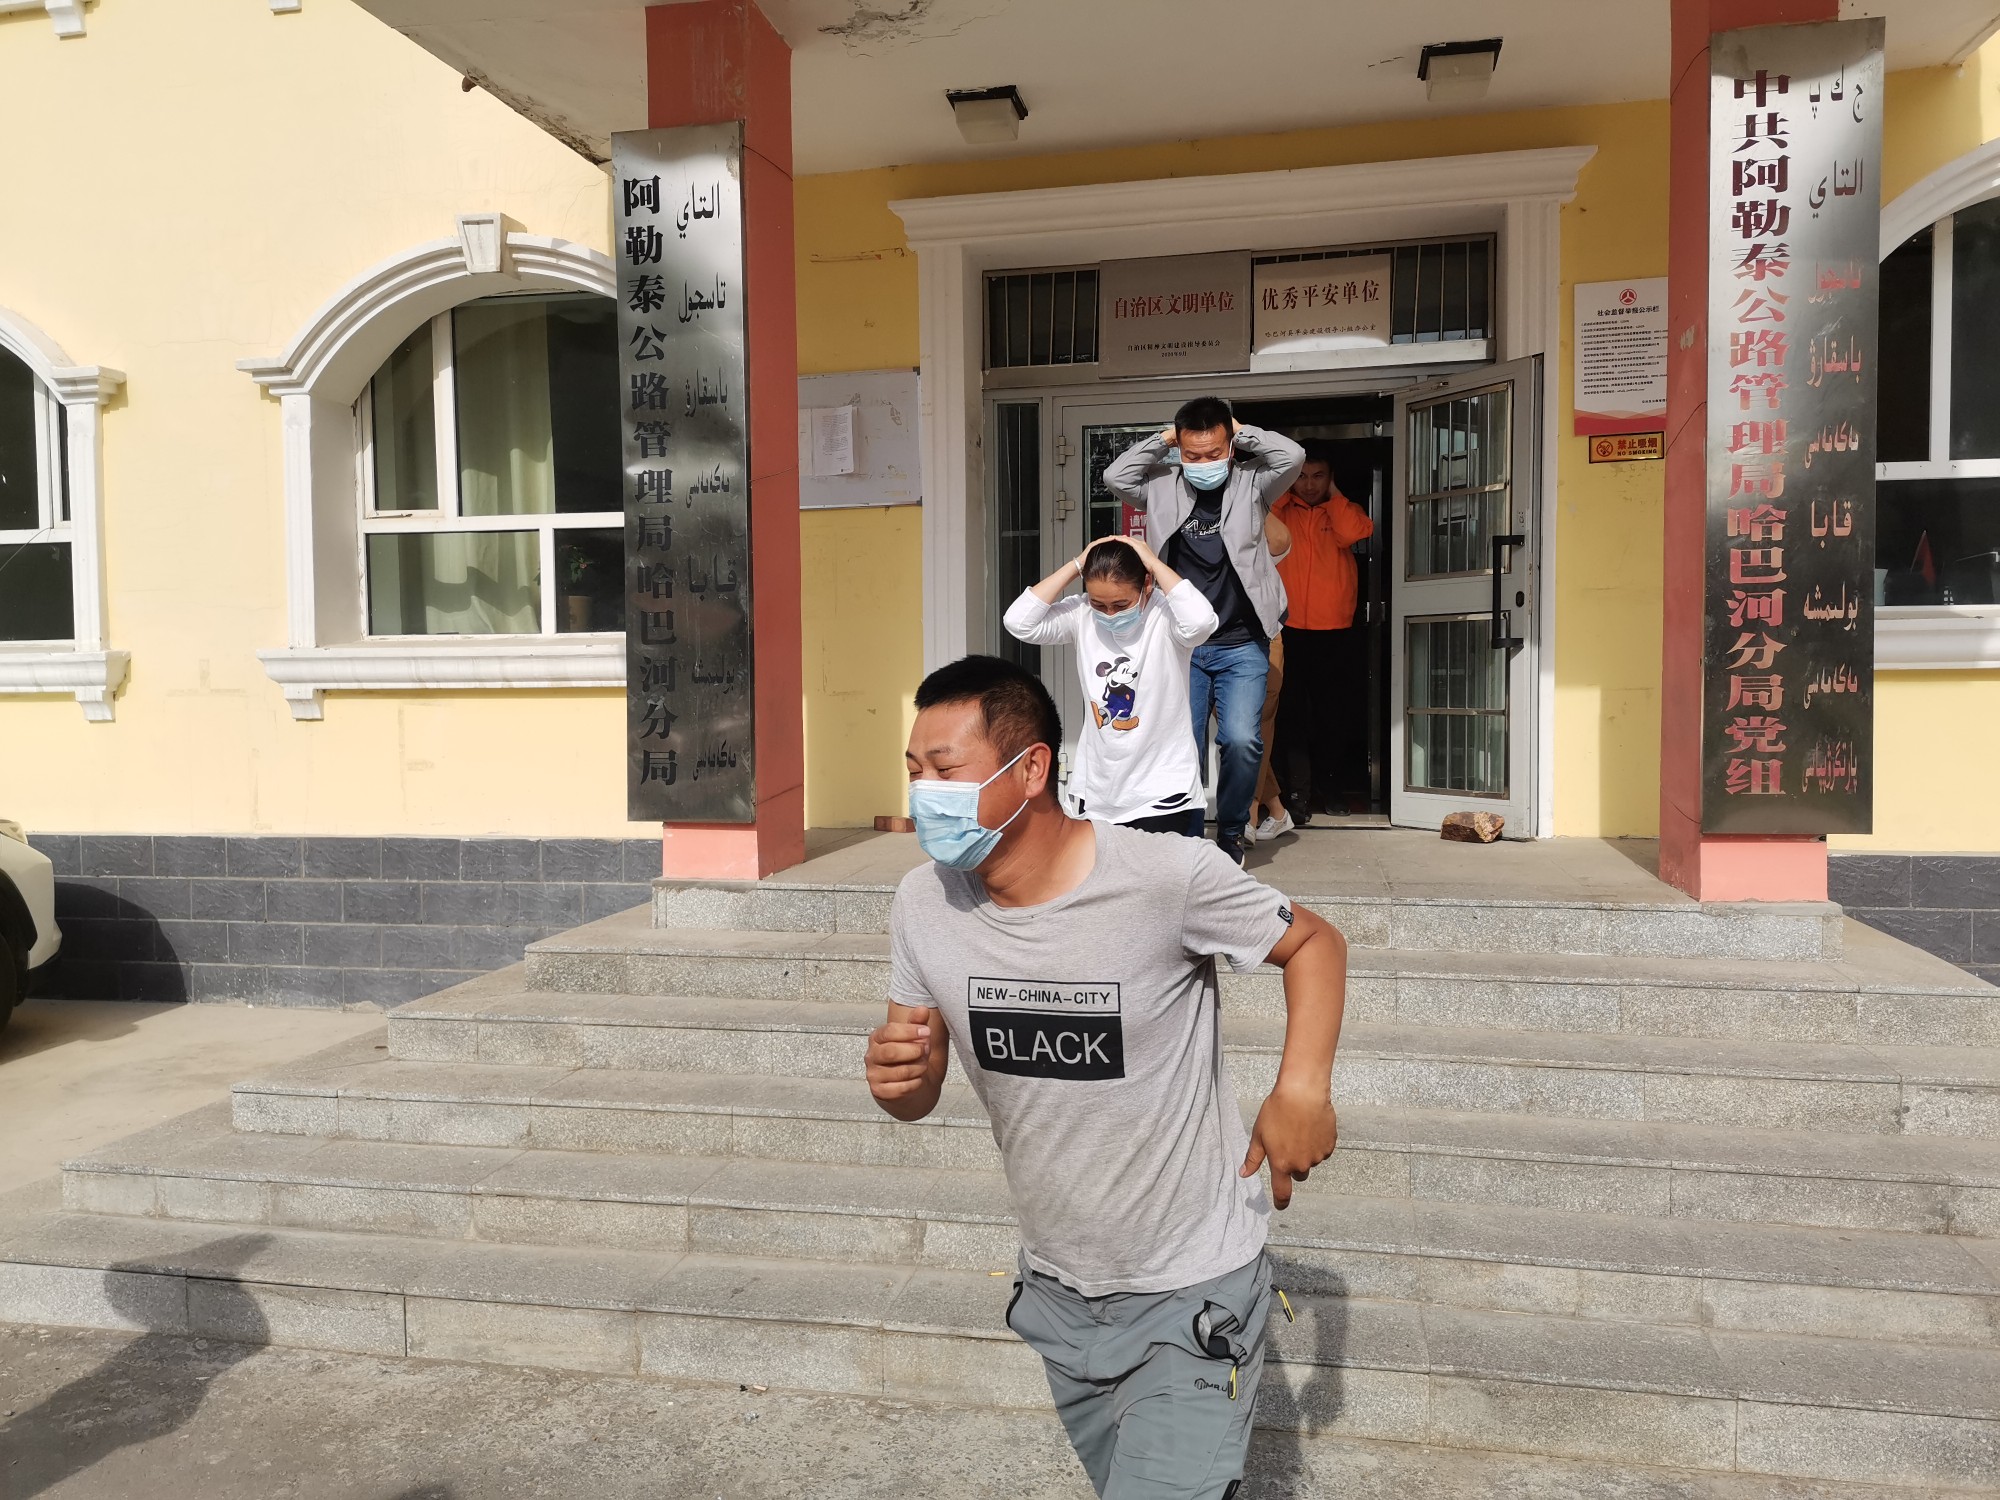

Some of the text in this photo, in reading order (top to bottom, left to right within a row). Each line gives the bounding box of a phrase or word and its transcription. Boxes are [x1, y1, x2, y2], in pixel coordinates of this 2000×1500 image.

[1114, 290, 1235, 319] 自治区文明单位
[1261, 279, 1380, 312] 优秀平安单位
[1597, 306, 1660, 317] 社会监督举报公示栏
[1617, 437, 1658, 450] 禁止吸烟
[1724, 69, 1791, 795] 中共阿勒泰公路管理局哈巴河分局党组
[1628, 448, 1658, 456] SMOKING
[623, 174, 679, 786] 阿勒泰公路管理局哈巴河分局
[976, 986, 1111, 1005] NEW-CHINA-CITY
[985, 1027, 1111, 1065] BLACK
